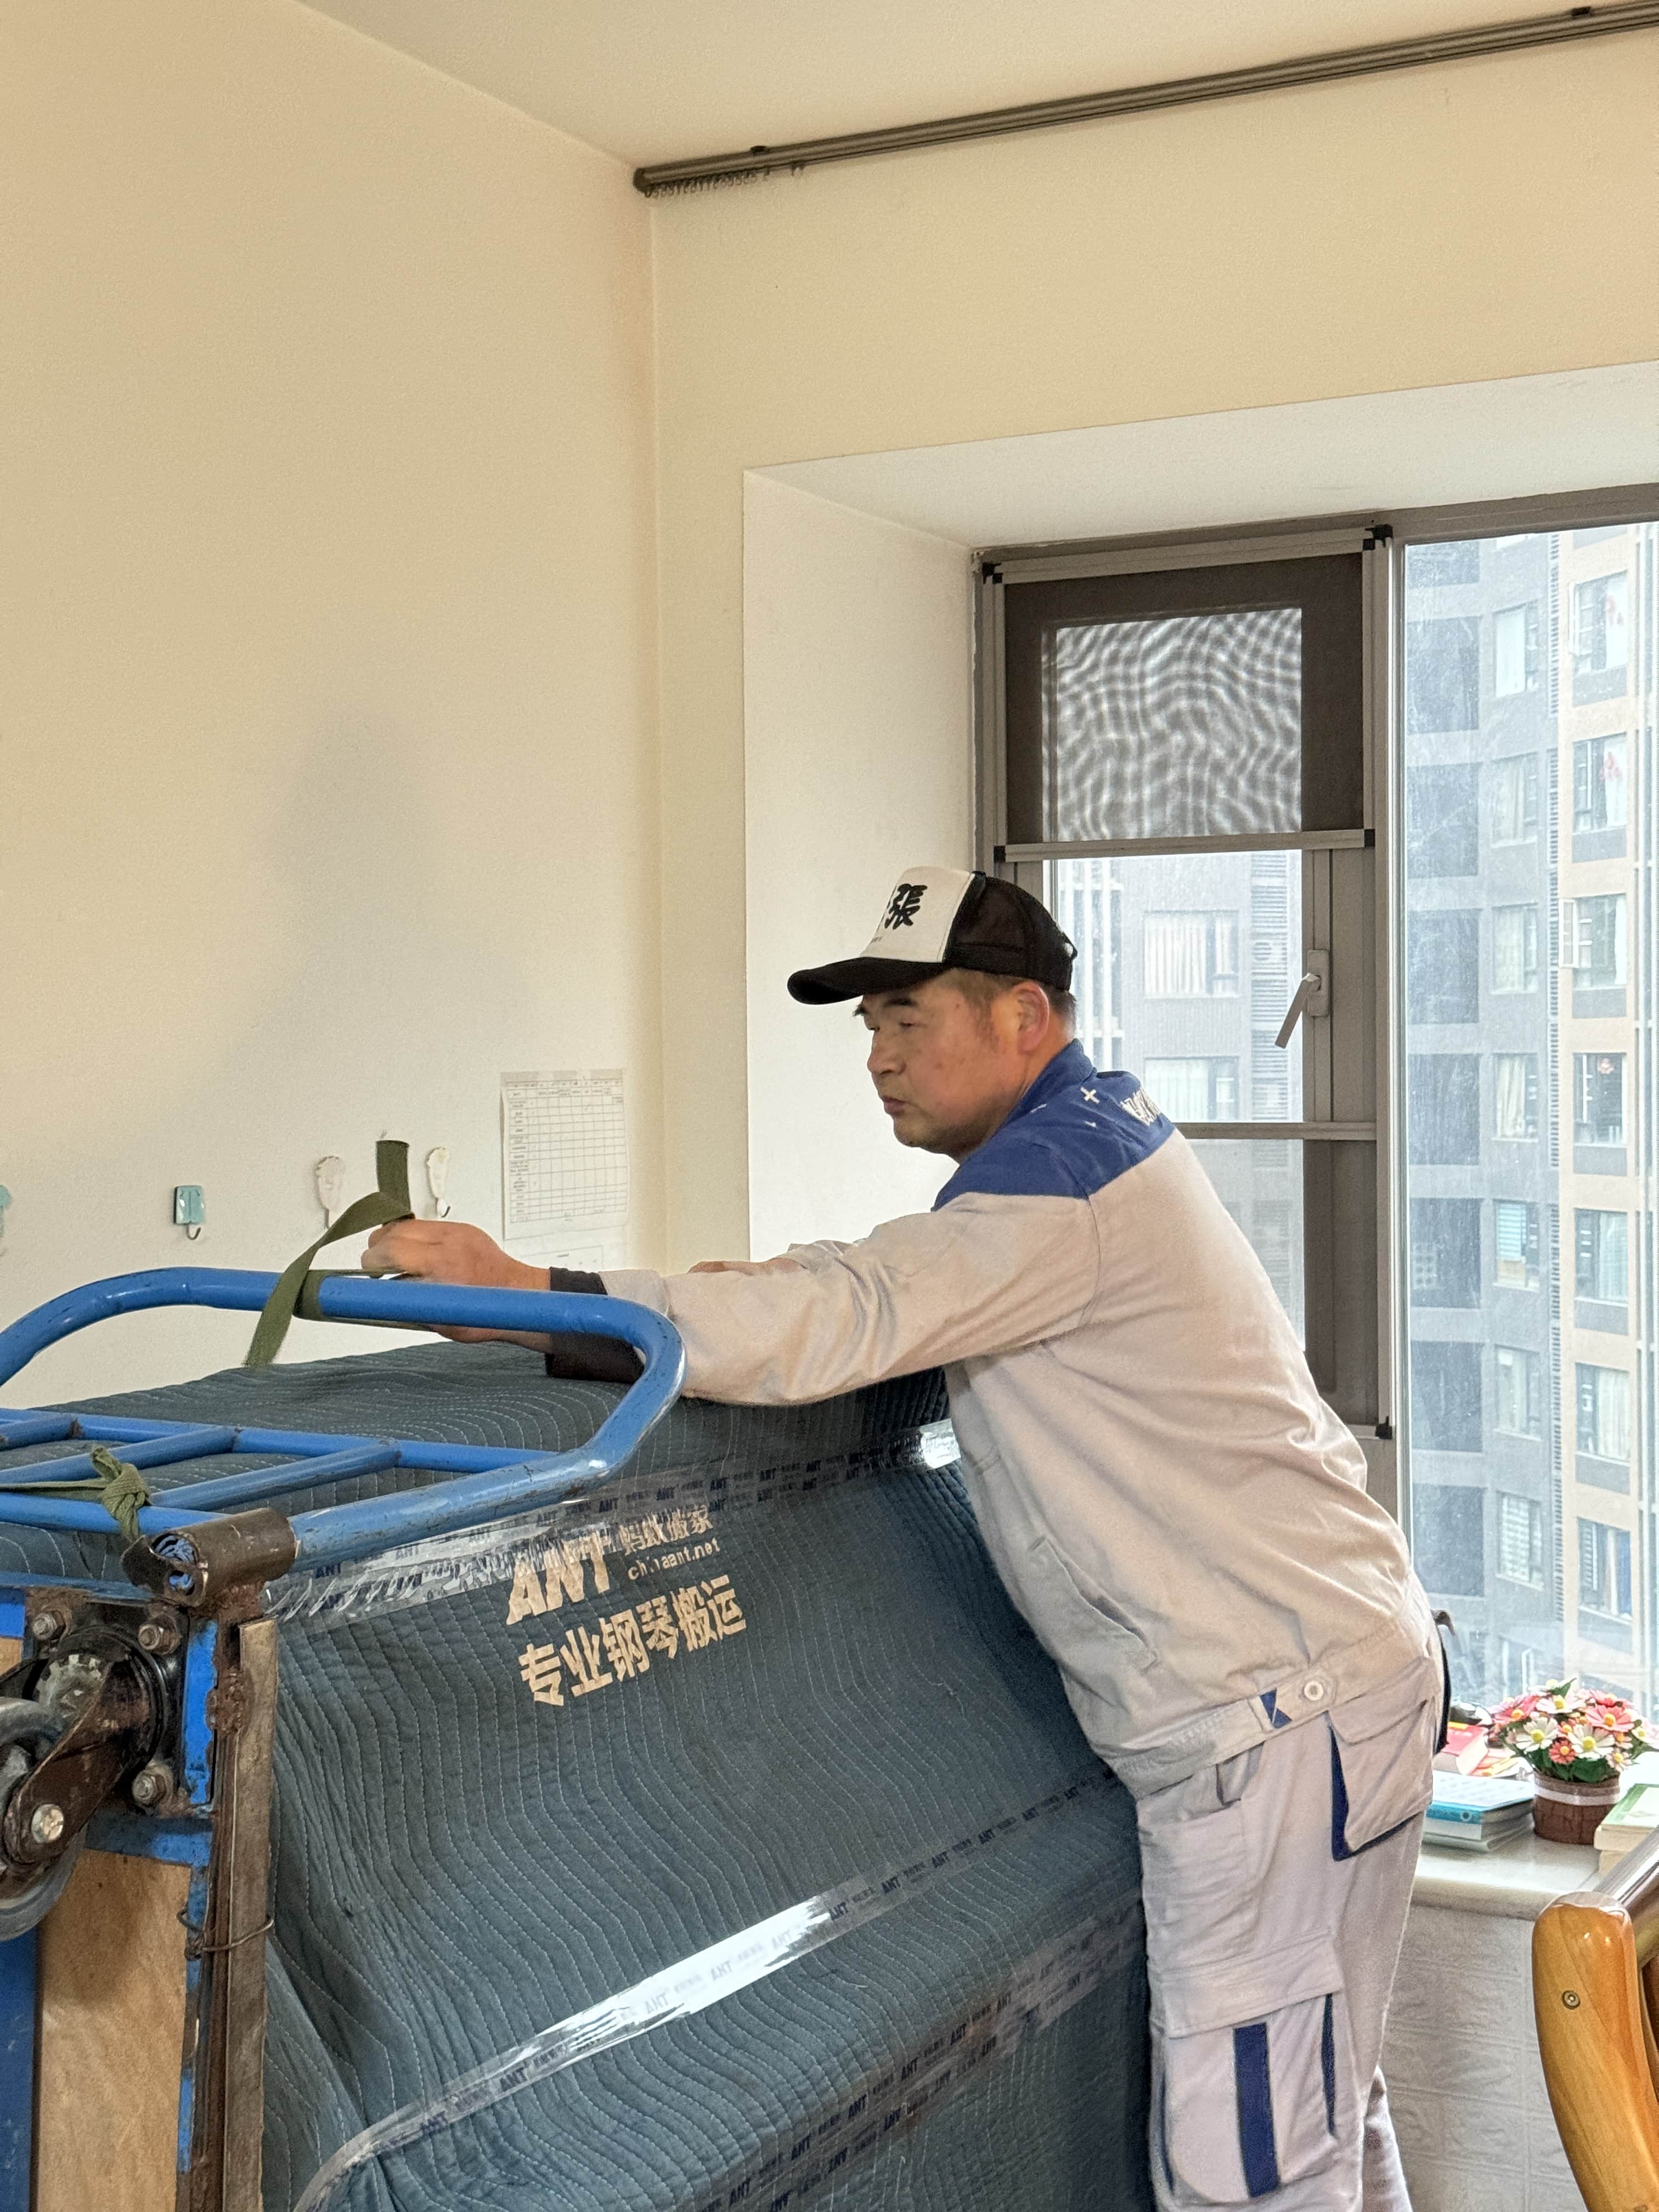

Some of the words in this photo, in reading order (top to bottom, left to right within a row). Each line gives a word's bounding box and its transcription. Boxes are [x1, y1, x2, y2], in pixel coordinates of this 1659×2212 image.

[518, 1575, 747, 1706] 专业钢琴搬运
[645, 1992, 669, 2015] ANT
[710, 1960, 733, 1982] ANT
[771, 1930, 793, 1950] ANT
[829, 1901, 848, 1921] ANT
[881, 1876, 901, 1894] ANT
